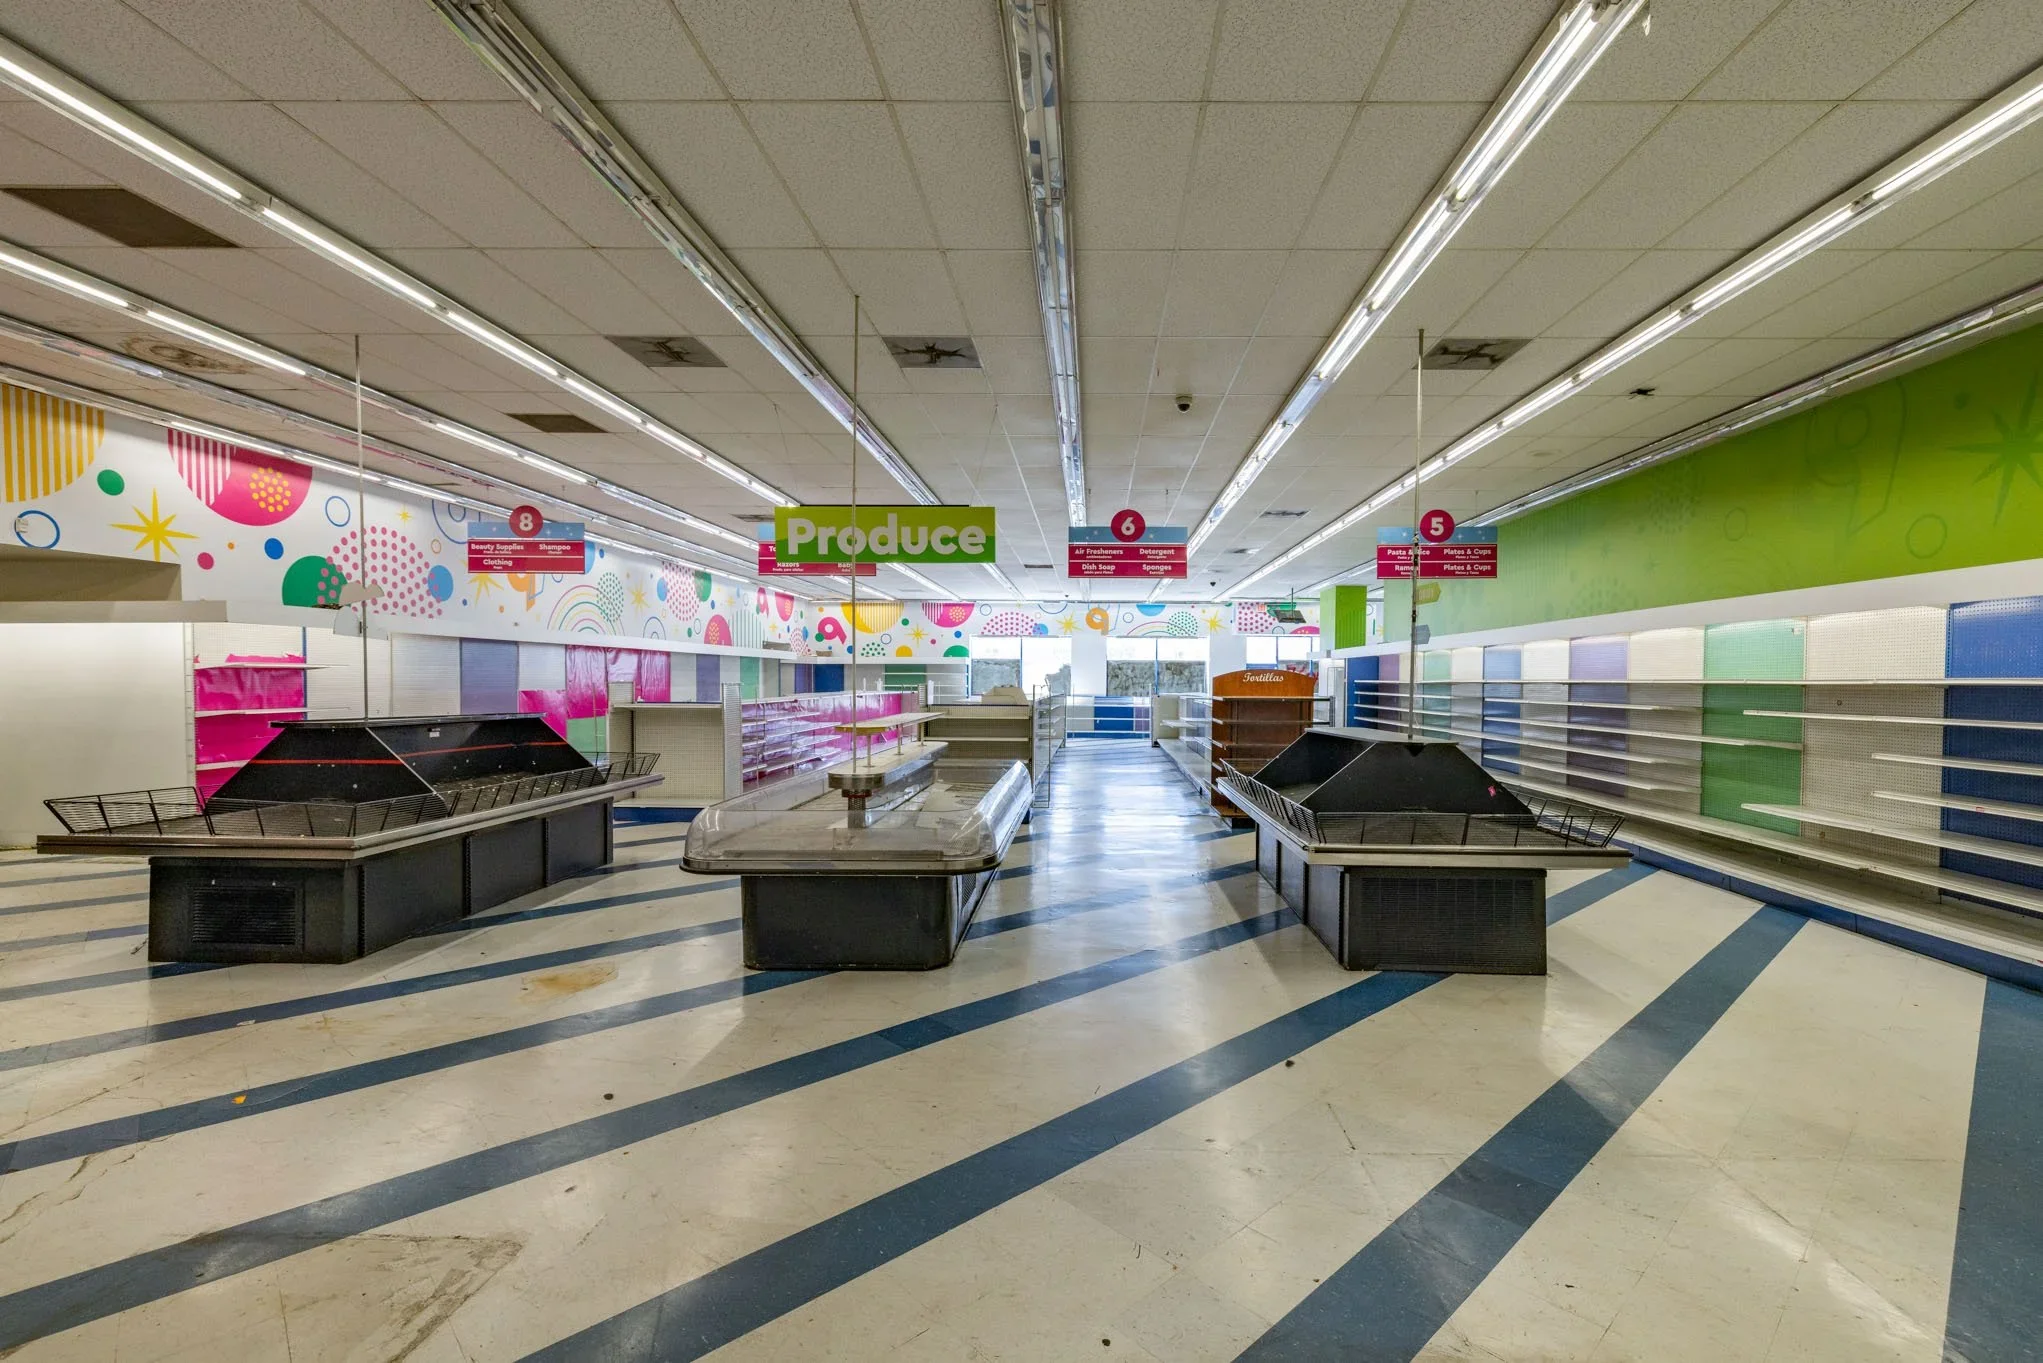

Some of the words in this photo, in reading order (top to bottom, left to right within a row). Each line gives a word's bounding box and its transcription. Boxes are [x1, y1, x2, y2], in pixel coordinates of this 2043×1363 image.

[519, 512, 534, 532] 8
[1121, 516, 1136, 536] 6
[1429, 516, 1445, 536] 5
[787, 512, 986, 556] Produce
[471, 543, 495, 551] Beauty
[496, 543, 524, 551] Supplies
[539, 543, 571, 551] Shampoo
[1139, 548, 1175, 556] Detergent
[1473, 548, 1492, 556] Cups
[483, 558, 513, 567] Clothing
[1098, 564, 1116, 572] Soap
[1473, 564, 1492, 572] Cups
[1242, 672, 1284, 683] Tortillas
